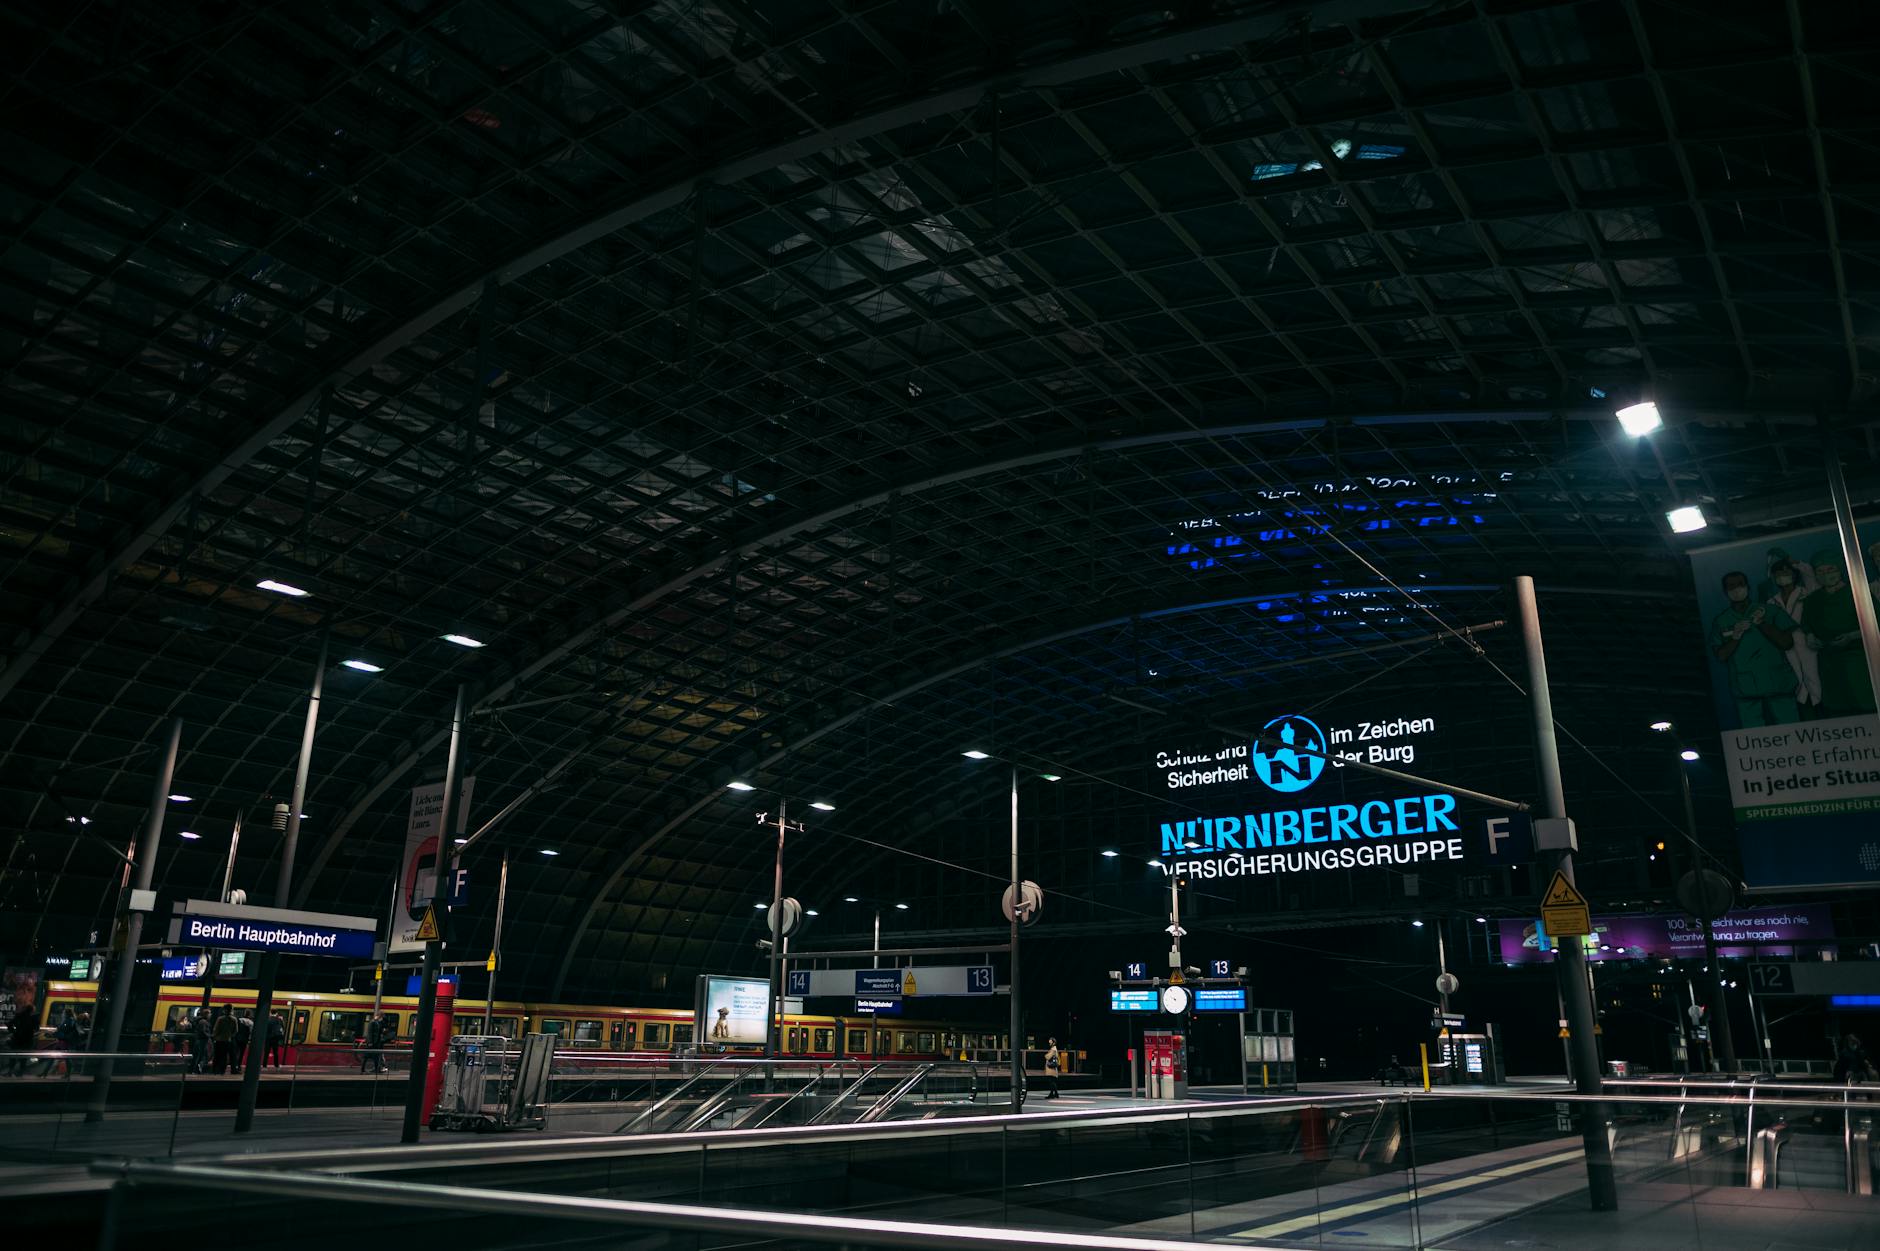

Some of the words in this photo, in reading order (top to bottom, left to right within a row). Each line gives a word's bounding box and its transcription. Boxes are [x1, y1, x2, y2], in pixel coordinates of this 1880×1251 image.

[1330, 727, 1353, 745] im
[1357, 717, 1435, 741] Zeichen
[1736, 733, 1790, 751] Unser
[1795, 725, 1872, 745] Wissen.
[1368, 744, 1414, 764] Burg
[1739, 753, 1806, 772] Unsere
[1167, 764, 1249, 788] Sicherheit
[1743, 779, 1762, 794] In
[1767, 773, 1820, 796] jeder
[1745, 802, 1845, 819] SPITZENMEDIZIN
[1486, 817, 1510, 855] F
[454, 869, 468, 898] F
[1734, 918, 1753, 927] war
[1754, 917, 1765, 926] es
[1767, 914, 1791, 925] noch
[190, 920, 235, 940] Berlin
[238, 924, 336, 949] Hauptbahnhof
[1734, 931, 1745, 940] zu
[1127, 963, 1141, 977] 14
[1214, 960, 1228, 975] 13
[1755, 965, 1783, 987] 12
[791, 973, 806, 990] 14
[972, 968, 990, 988] 13
[467, 1056, 474, 1066] 2
[610, 1087, 618, 1100] H
